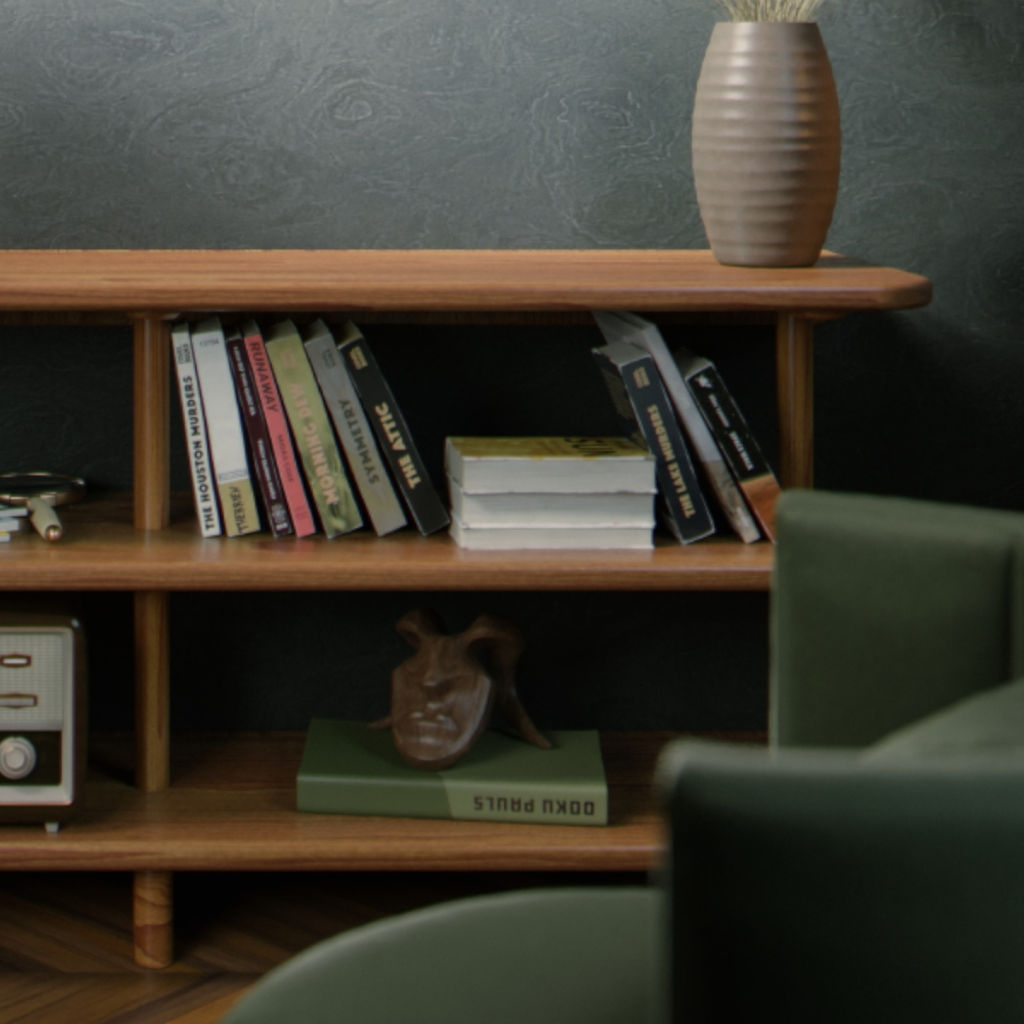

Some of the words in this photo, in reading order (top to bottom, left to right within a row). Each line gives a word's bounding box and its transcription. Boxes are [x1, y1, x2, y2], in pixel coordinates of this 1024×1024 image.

[249, 342, 279, 413] RUNAWAY
[288, 384, 312, 419] DEW
[183, 376, 200, 438] MURDERS
[374, 401, 407, 452] ATTIC
[647, 404, 675, 462] MURDERS
[303, 422, 340, 505] MORNING
[338, 399, 381, 485] SYMMETRY
[192, 440, 209, 502] HOUSTON
[398, 453, 422, 489] THE
[204, 506, 214, 530] THE
[679, 493, 697, 519] THE
[473, 795, 535, 813] PAULS
